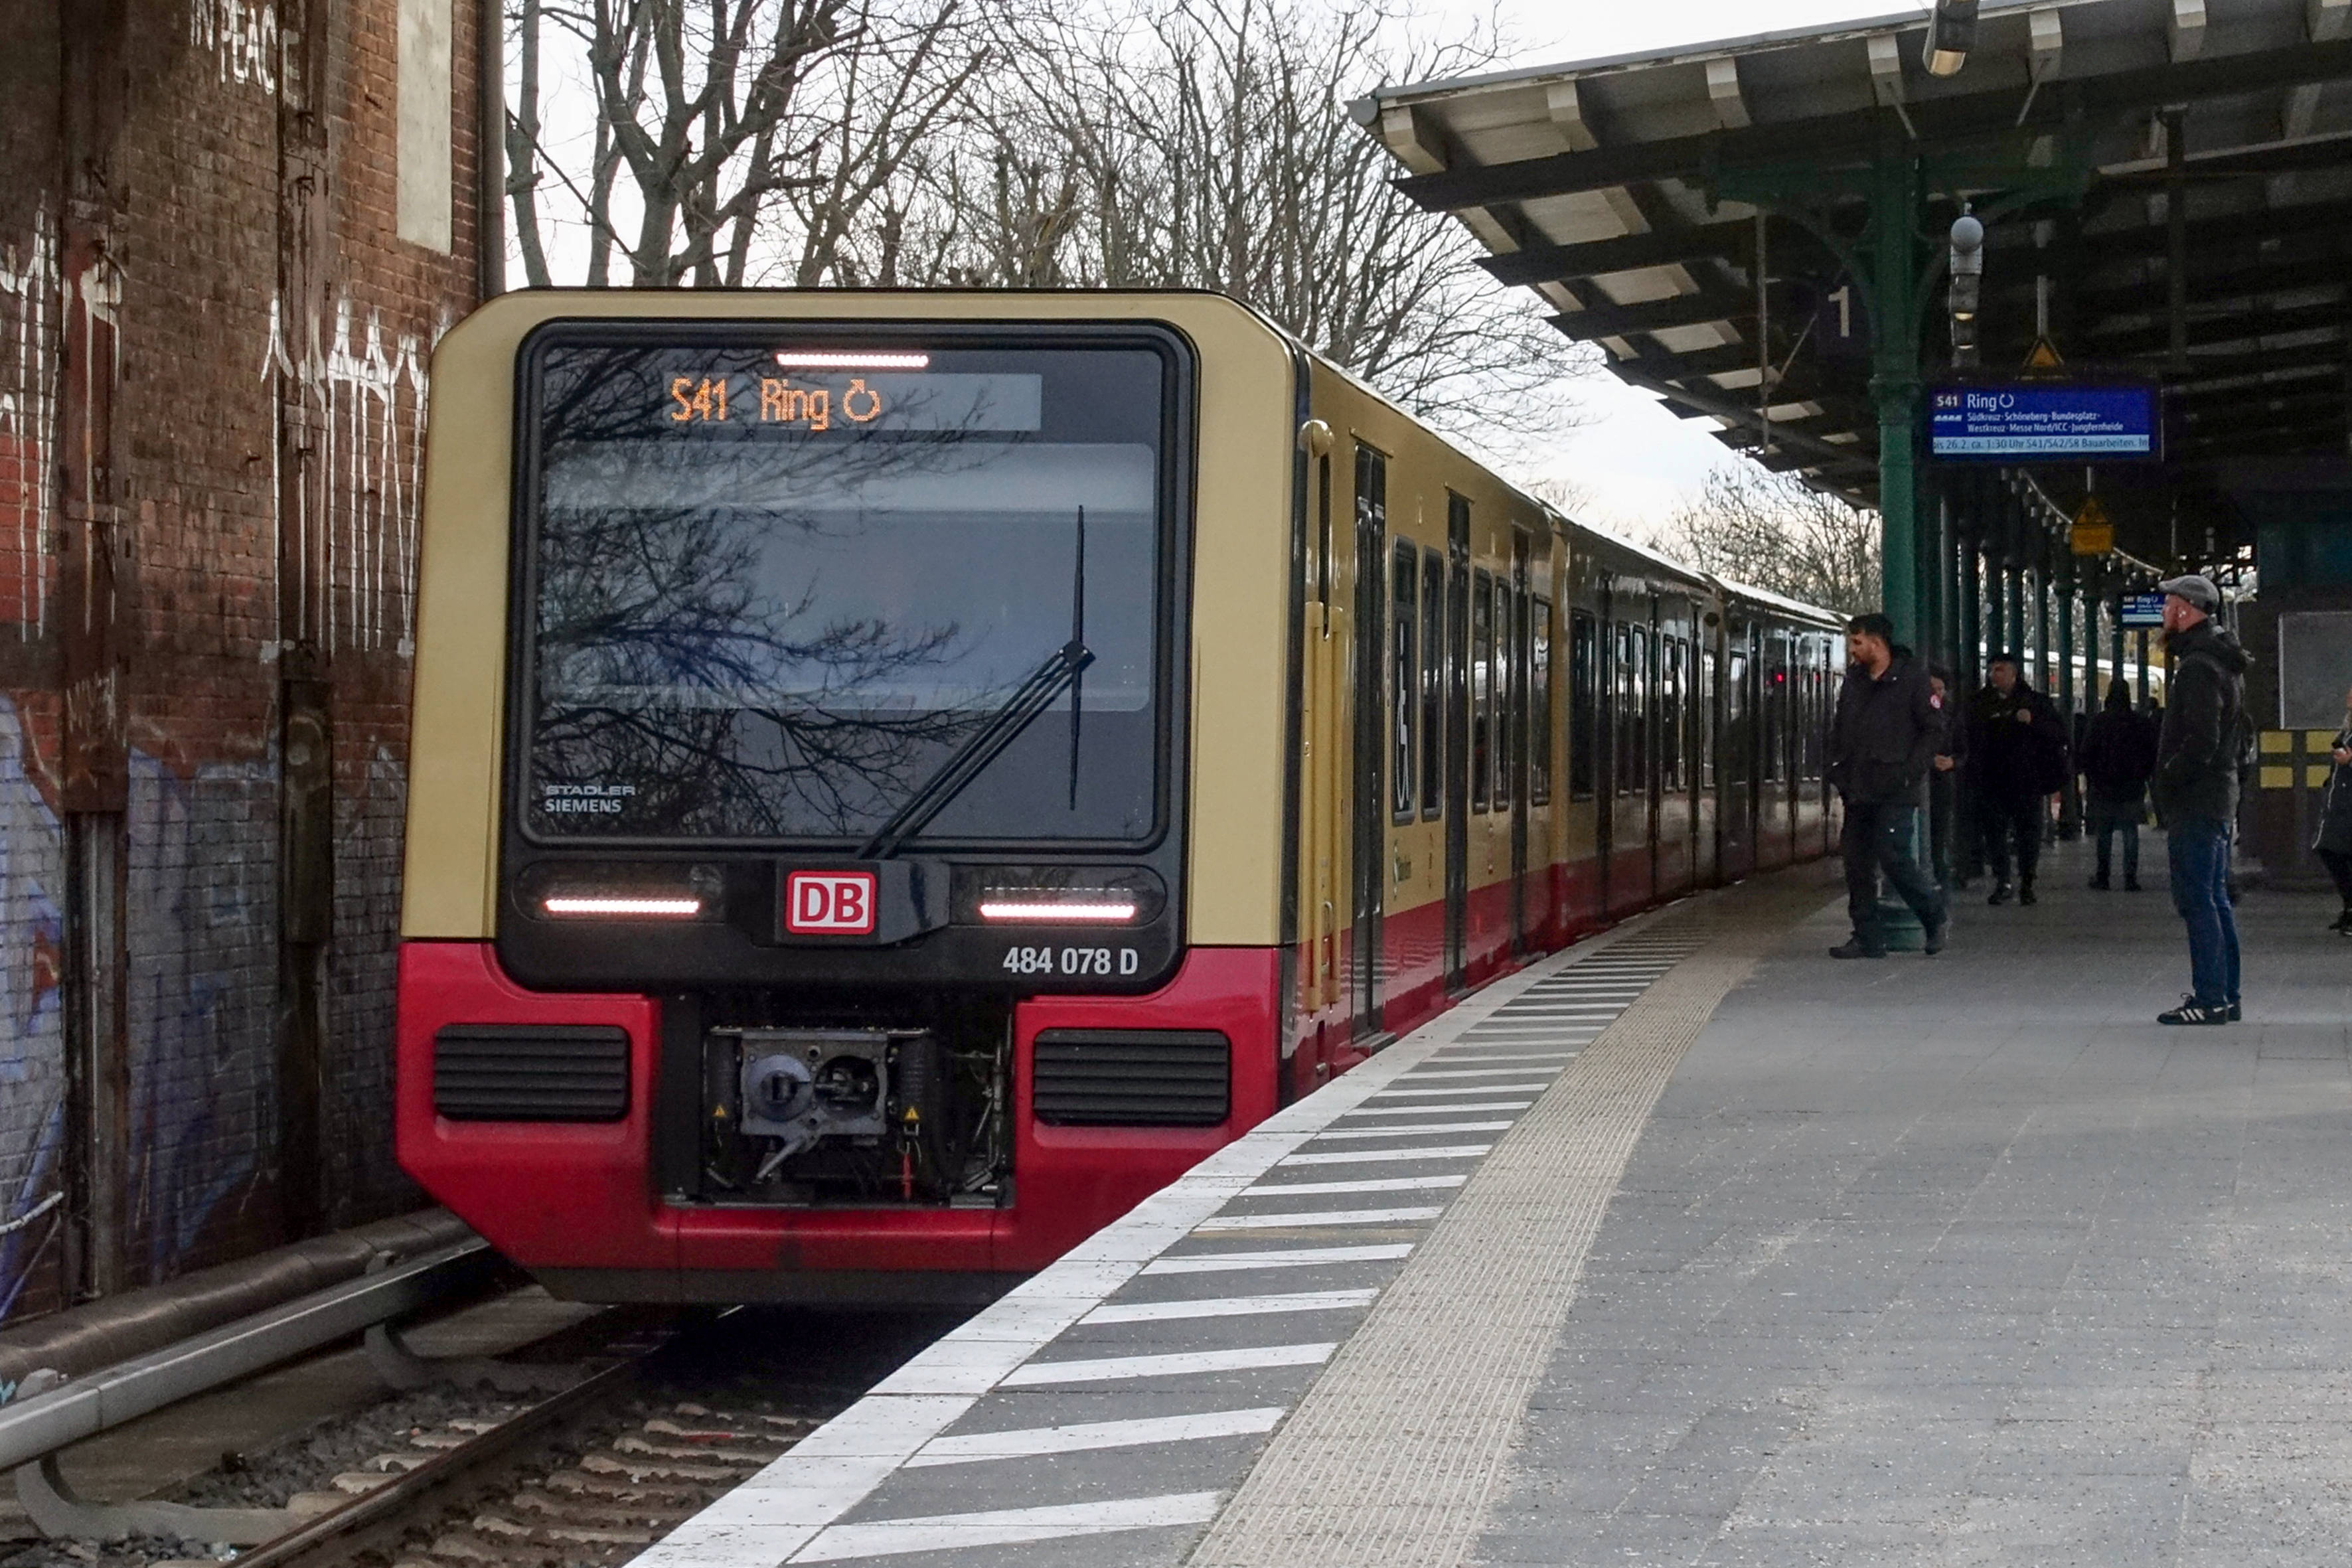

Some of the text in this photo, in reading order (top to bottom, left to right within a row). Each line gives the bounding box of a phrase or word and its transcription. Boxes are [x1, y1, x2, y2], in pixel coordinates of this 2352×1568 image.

[220, 0, 300, 110] PEACE
[1828, 286, 1849, 337] 1
[671, 378, 830, 431] S41 Ring
[1936, 394, 1997, 412] S41 Ring
[1967, 424, 2005, 433] Westkreuz
[2009, 423, 2033, 433] Messe
[1987, 439, 2007, 449] 1:30
[2009, 439, 2024, 449] Uhr
[546, 785, 636, 796] STADLER
[545, 799, 622, 813] SIEMENS
[799, 882, 864, 923] DB
[1003, 947, 1138, 975] 484 078 D
